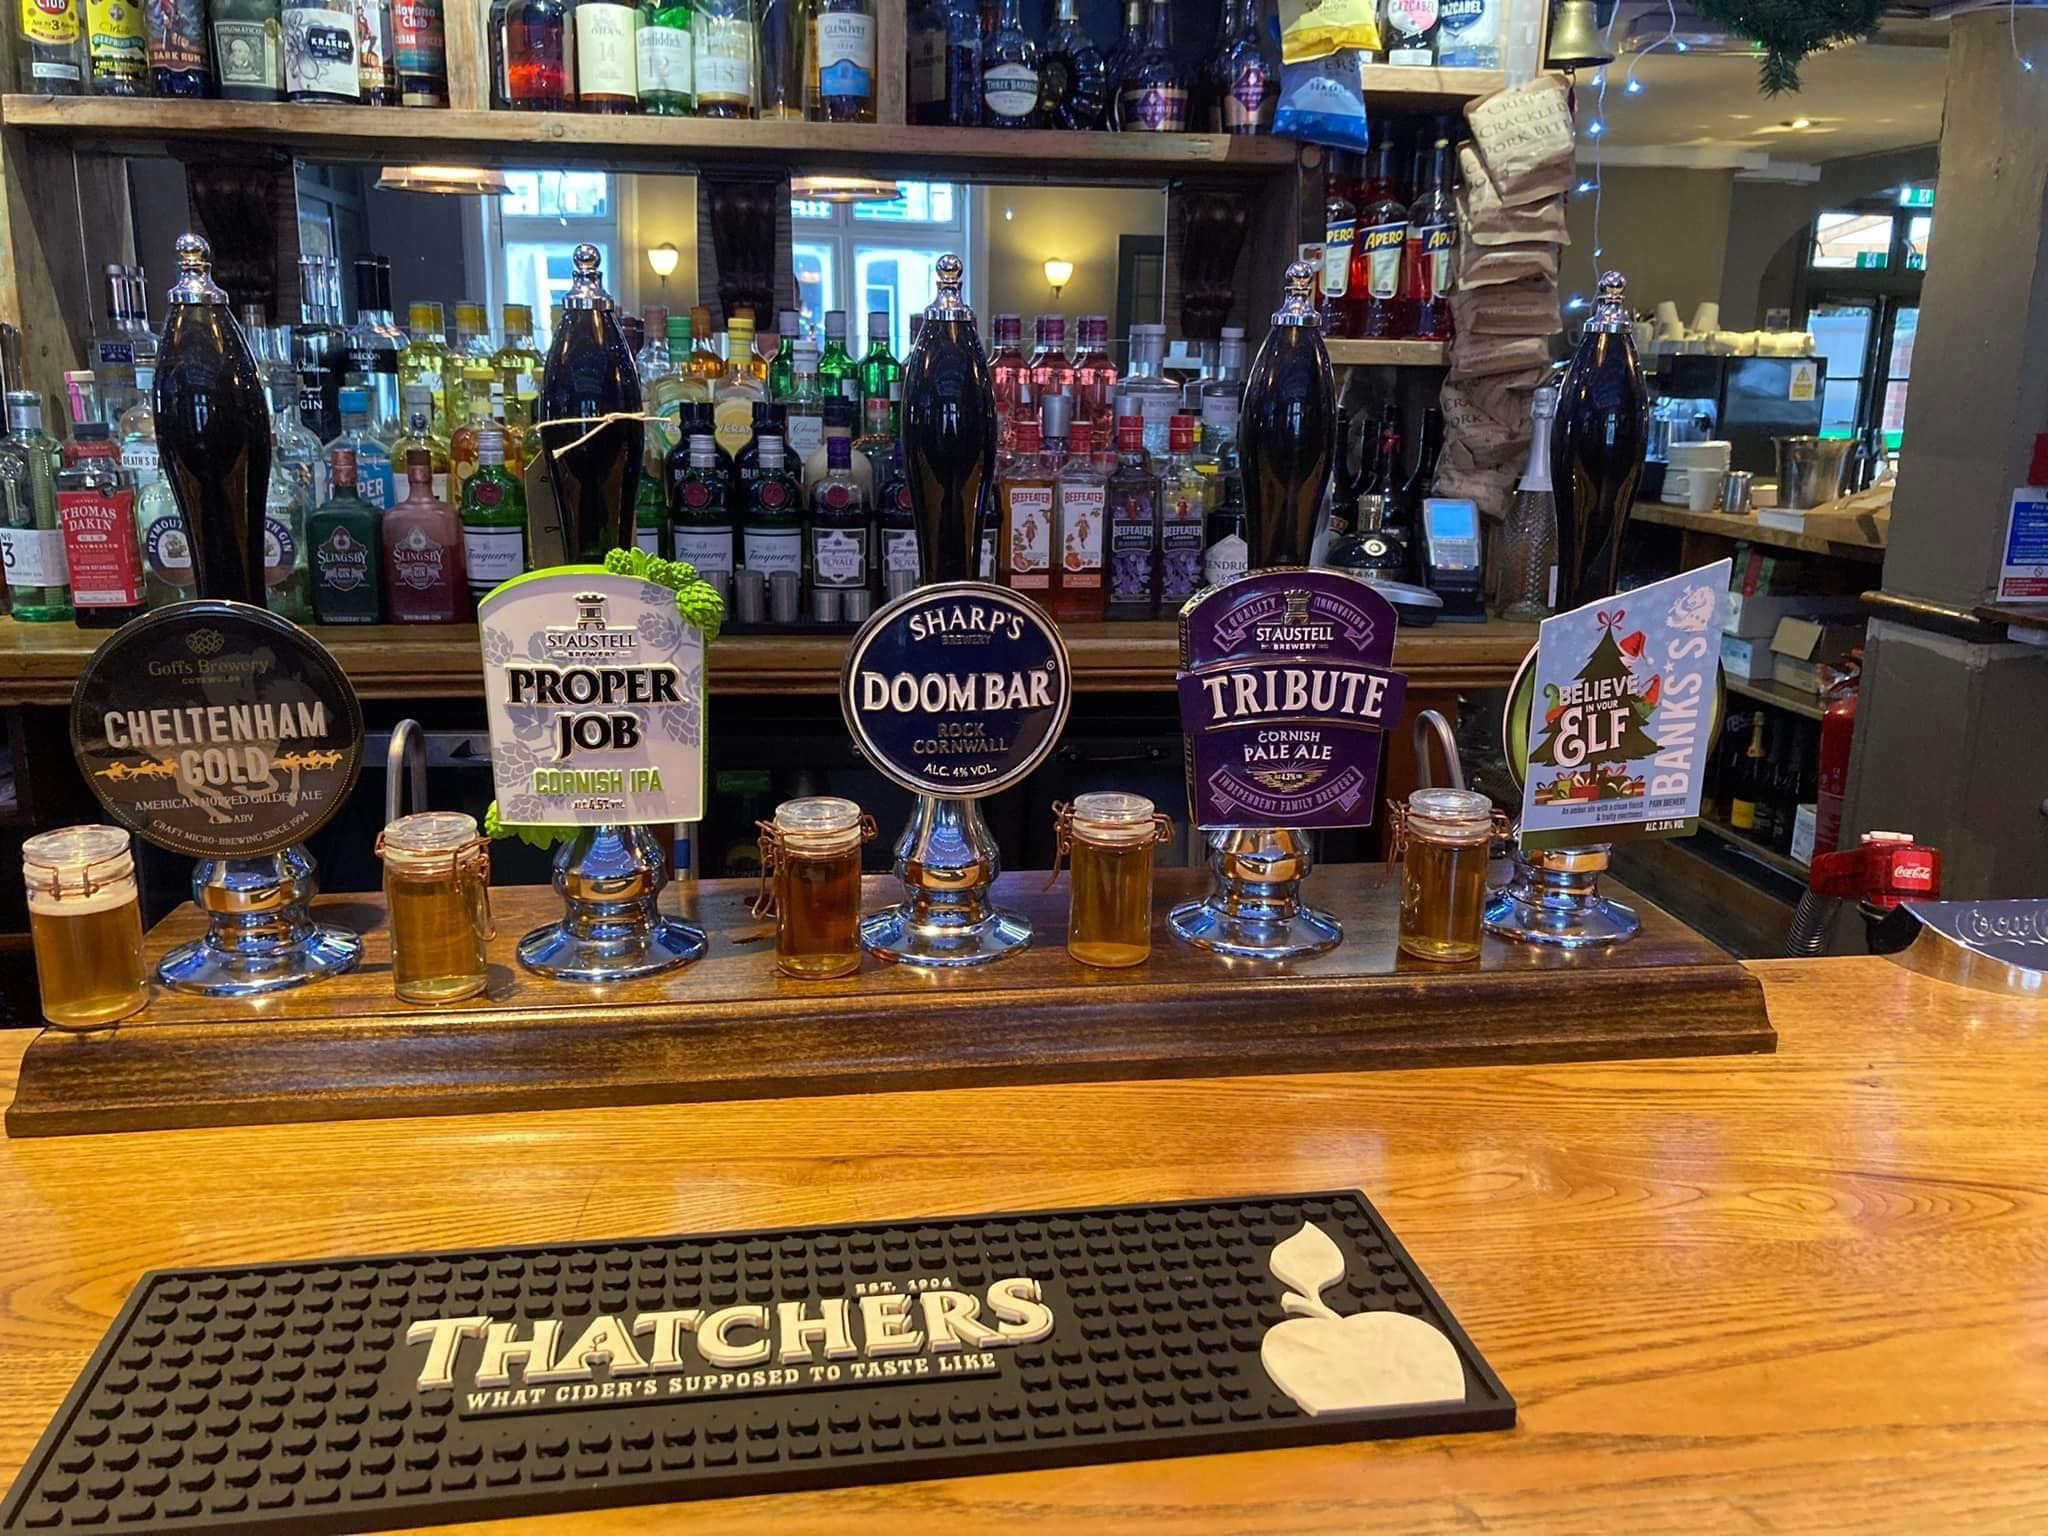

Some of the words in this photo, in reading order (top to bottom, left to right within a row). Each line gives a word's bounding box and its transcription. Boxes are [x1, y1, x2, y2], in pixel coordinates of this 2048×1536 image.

[1391, 2, 1434, 13] CAZCABEL
[1441, 1, 1482, 16] CAZCABEL
[52, 20, 60, 30] 3
[402, 16, 428, 28] Club
[825, 25, 865, 35] GLENLIVET
[311, 38, 350, 49] KRAKEN
[181, 52, 202, 63] RUM
[1365, 231, 1404, 250] APERO
[300, 400, 323, 410] GIN
[123, 456, 150, 466] DEATH'S
[1011, 492, 1050, 505] BEEFEATER
[1064, 491, 1104, 504] BEEFEATER
[62, 506, 117, 520] THOMAS
[69, 518, 113, 531] DAKIN
[1113, 526, 1152, 536] BEEFEATER
[1162, 526, 1201, 537] BEEFEATER
[148, 518, 183, 553] PLYMOUT
[279, 532, 294, 552] GIN
[2, 542, 16, 568] 3
[317, 550, 368, 564] SLINGSBY
[394, 549, 444, 564] SLINGSBY
[468, 548, 518, 562] Tanqueray
[680, 548, 728, 562] Tanqueray
[1228, 597, 1276, 628] QUALITY
[1313, 596, 1367, 630] INNOVATION
[909, 604, 1024, 641] SHARP'S
[566, 634, 637, 647] AUSTELL
[941, 634, 991, 645] BREWERY
[1272, 627, 1334, 641] AUSTELL
[198, 658, 270, 676] Brewery
[507, 666, 685, 705] PROPER
[862, 671, 977, 712] DOOM
[1560, 674, 1640, 706] BELIEVE
[1202, 669, 1389, 720] TRIBUTE
[1586, 703, 1595, 713] IN
[1597, 700, 1619, 711] YOUR
[104, 702, 328, 750] CHELTENHAM
[937, 723, 985, 738] ROCK
[553, 713, 641, 761] JOB
[1258, 730, 1320, 744] CORNISH
[1553, 706, 1630, 768] ELF
[912, 738, 1008, 755] CORNWALL
[1244, 744, 1290, 762] PALE
[1293, 744, 1333, 760] ALE
[180, 747, 270, 786] GOLD
[923, 763, 950, 777] ALC.
[953, 765, 969, 777] 4%
[534, 769, 623, 794] CORNISH
[629, 767, 664, 793] IPA
[301, 789, 322, 801] ALE
[1218, 773, 1276, 811] INDEPENDENT
[1280, 797, 1313, 812] FAMILY
[1317, 772, 1355, 803] BREWERS
[234, 814, 255, 824] ABV
[152, 819, 182, 838] CRAFT
[185, 831, 263, 846] MICRO-BREWING
[263, 824, 290, 840] SINCE
[855, 1281, 897, 1294] EST.
[908, 1276, 952, 1292] 1904
[406, 1278, 1054, 1393] THATCHERS
[467, 1387, 546, 1410] WHAT
[555, 1378, 657, 1402] CIDER'S
[668, 1368, 800, 1394] SUPPOSED
[809, 1365, 842, 1383] TO
[850, 1357, 929, 1380] TASTE
[938, 1352, 997, 1373] LIKE
